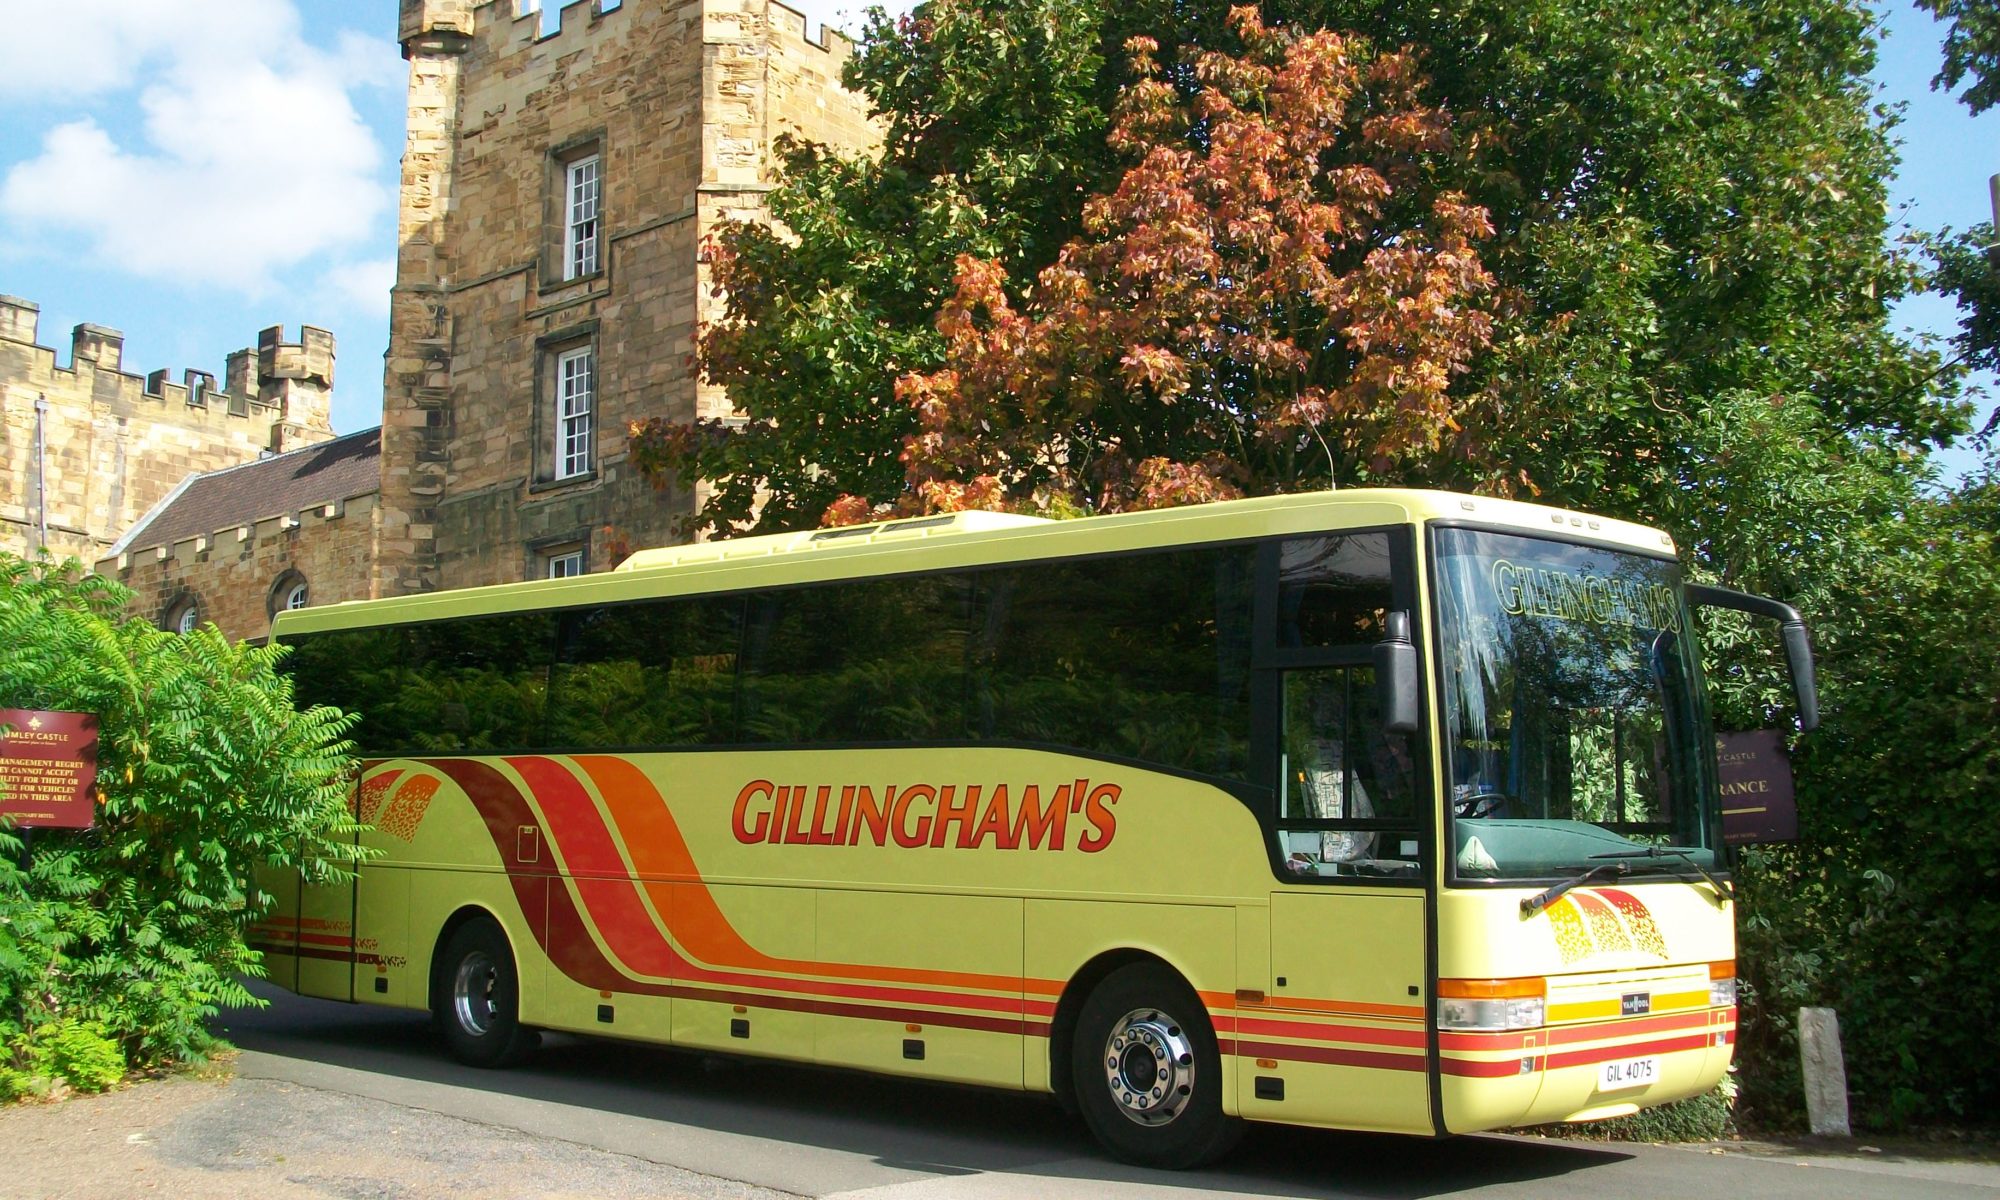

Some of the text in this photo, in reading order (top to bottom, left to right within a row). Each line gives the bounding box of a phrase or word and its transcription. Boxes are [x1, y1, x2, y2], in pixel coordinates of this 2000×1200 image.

[4, 731, 69, 742] UMLEY CASTLE
[1724, 752, 1757, 761] CASTLE
[11, 767, 44, 775] CANNOT
[45, 769, 75, 777] ACCEPT
[0, 775, 21, 783] ILITY
[41, 777, 66, 785] THEFT
[20, 784, 36, 792] FOR
[38, 785, 76, 794] VEHICLES
[1719, 780, 1768, 796] RANCE
[31, 793, 50, 801] THIS
[52, 794, 72, 802] AREA
[731, 778, 1122, 853] GILLINGHAM'S
[1607, 1060, 1652, 1082] GIL 4075
